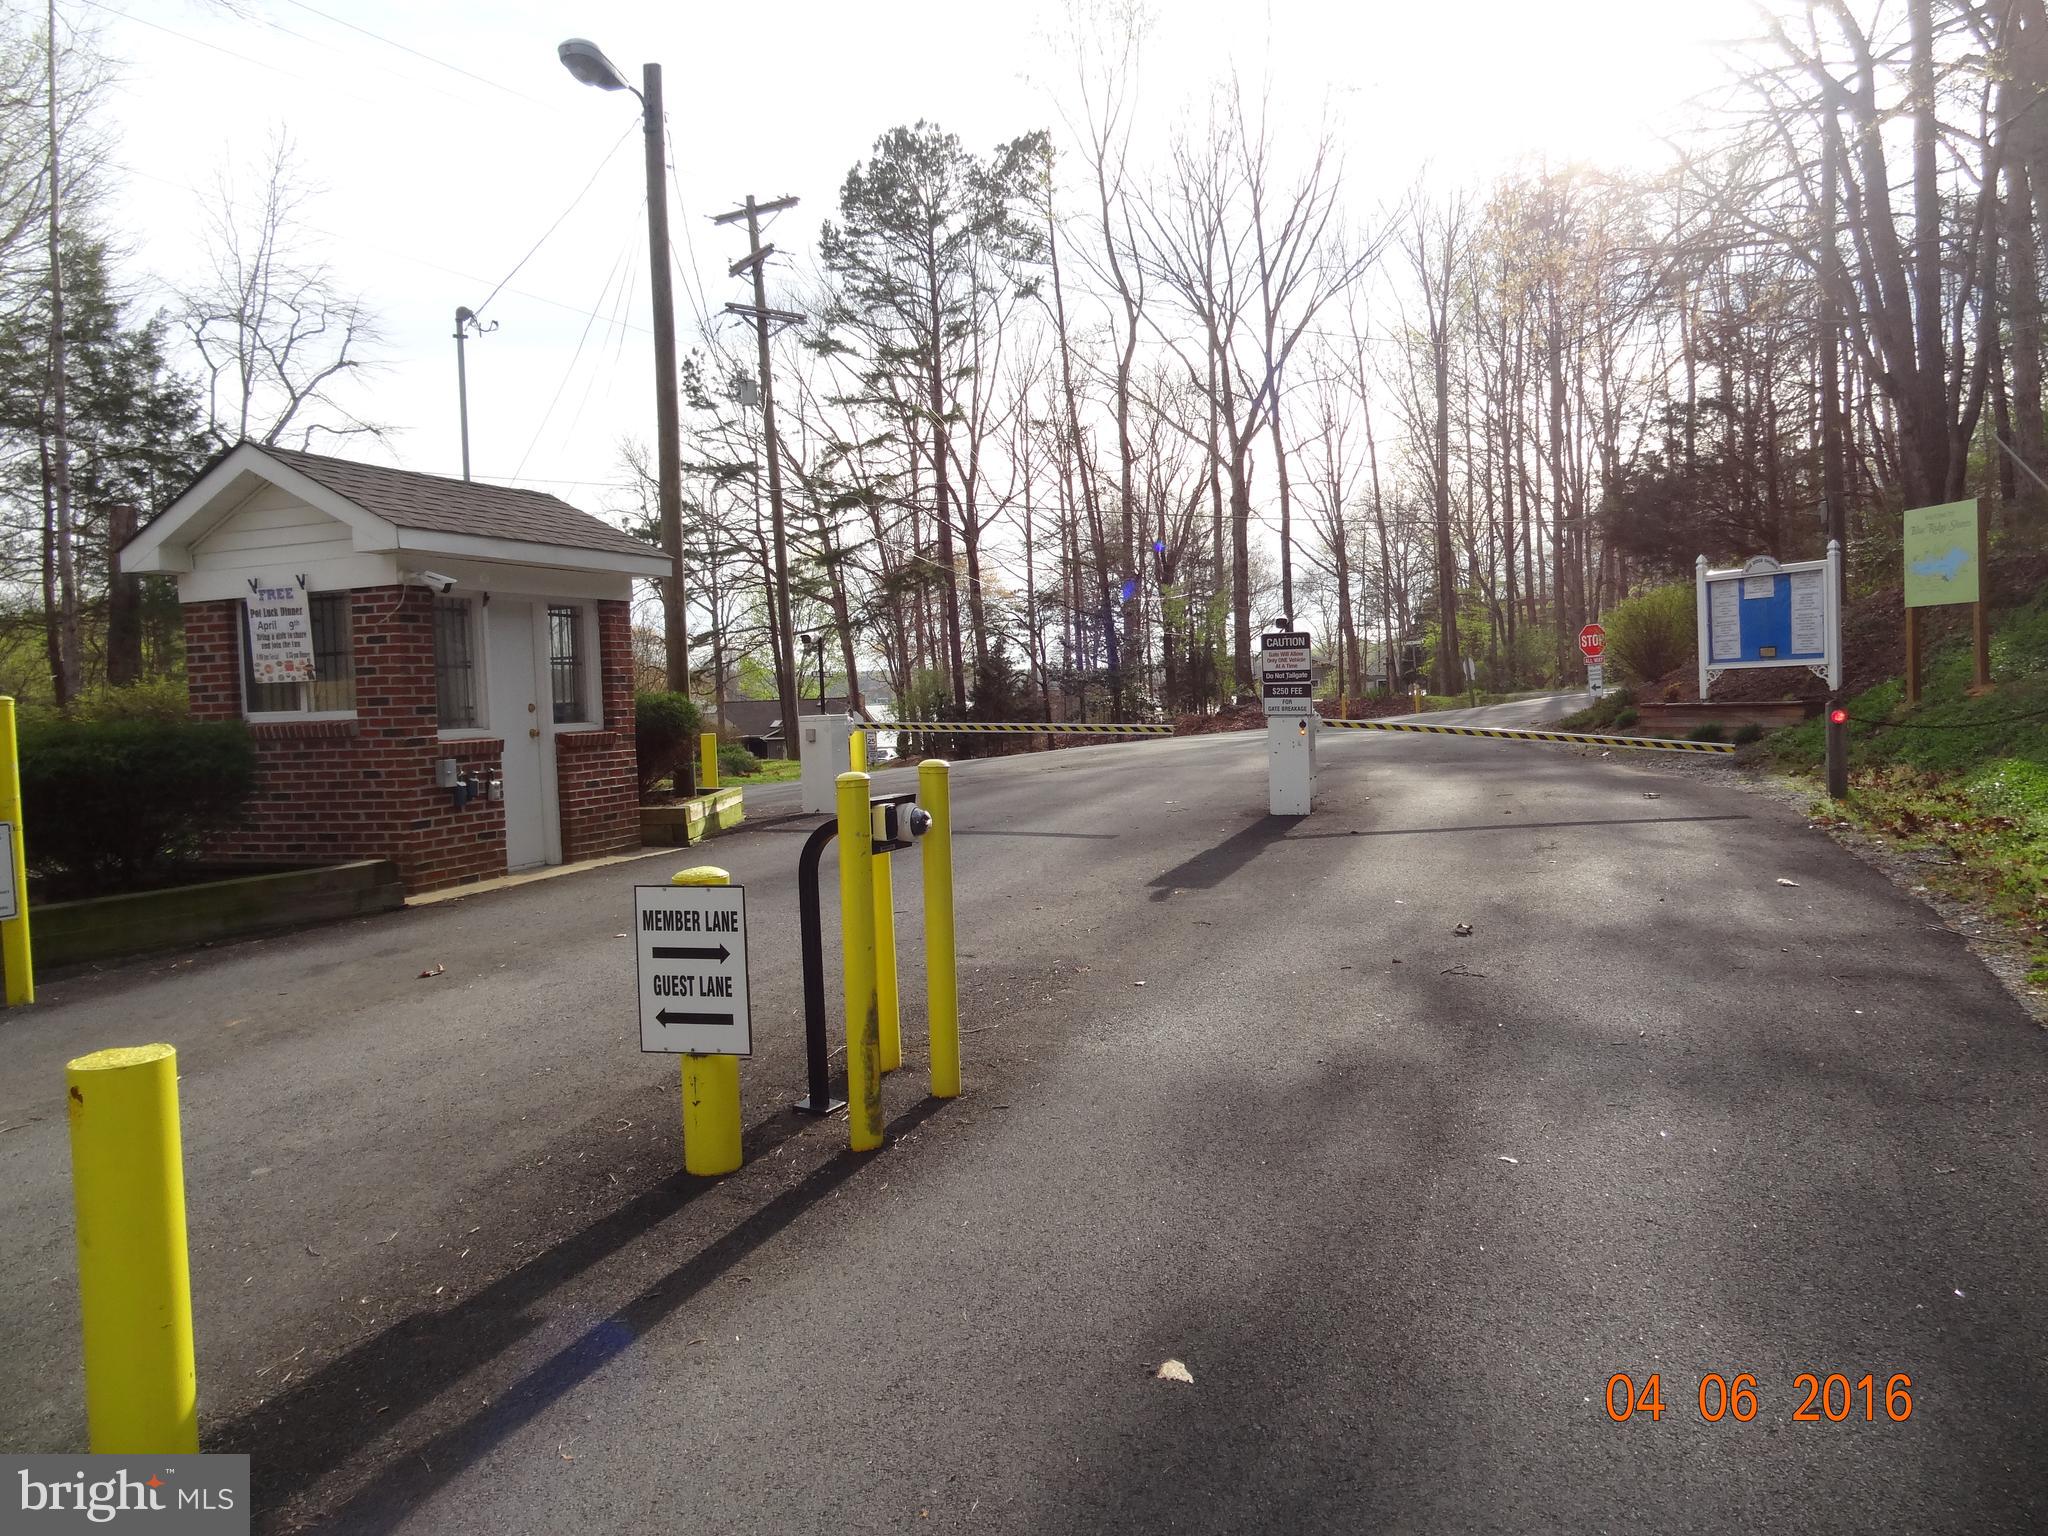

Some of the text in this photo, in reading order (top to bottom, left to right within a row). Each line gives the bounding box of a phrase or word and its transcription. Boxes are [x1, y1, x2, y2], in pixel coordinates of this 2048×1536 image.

[257, 588, 294, 601] FREE
[250, 607, 302, 618] Pot Luck Dinner
[257, 621, 277, 632] April
[1266, 637, 1305, 648] CAUTION
[1581, 634, 1605, 647] STOP
[1285, 672, 1308, 680] Tailgate
[642, 909, 739, 932] MEMBER LANE
[653, 974, 733, 997] GUEST LANE
